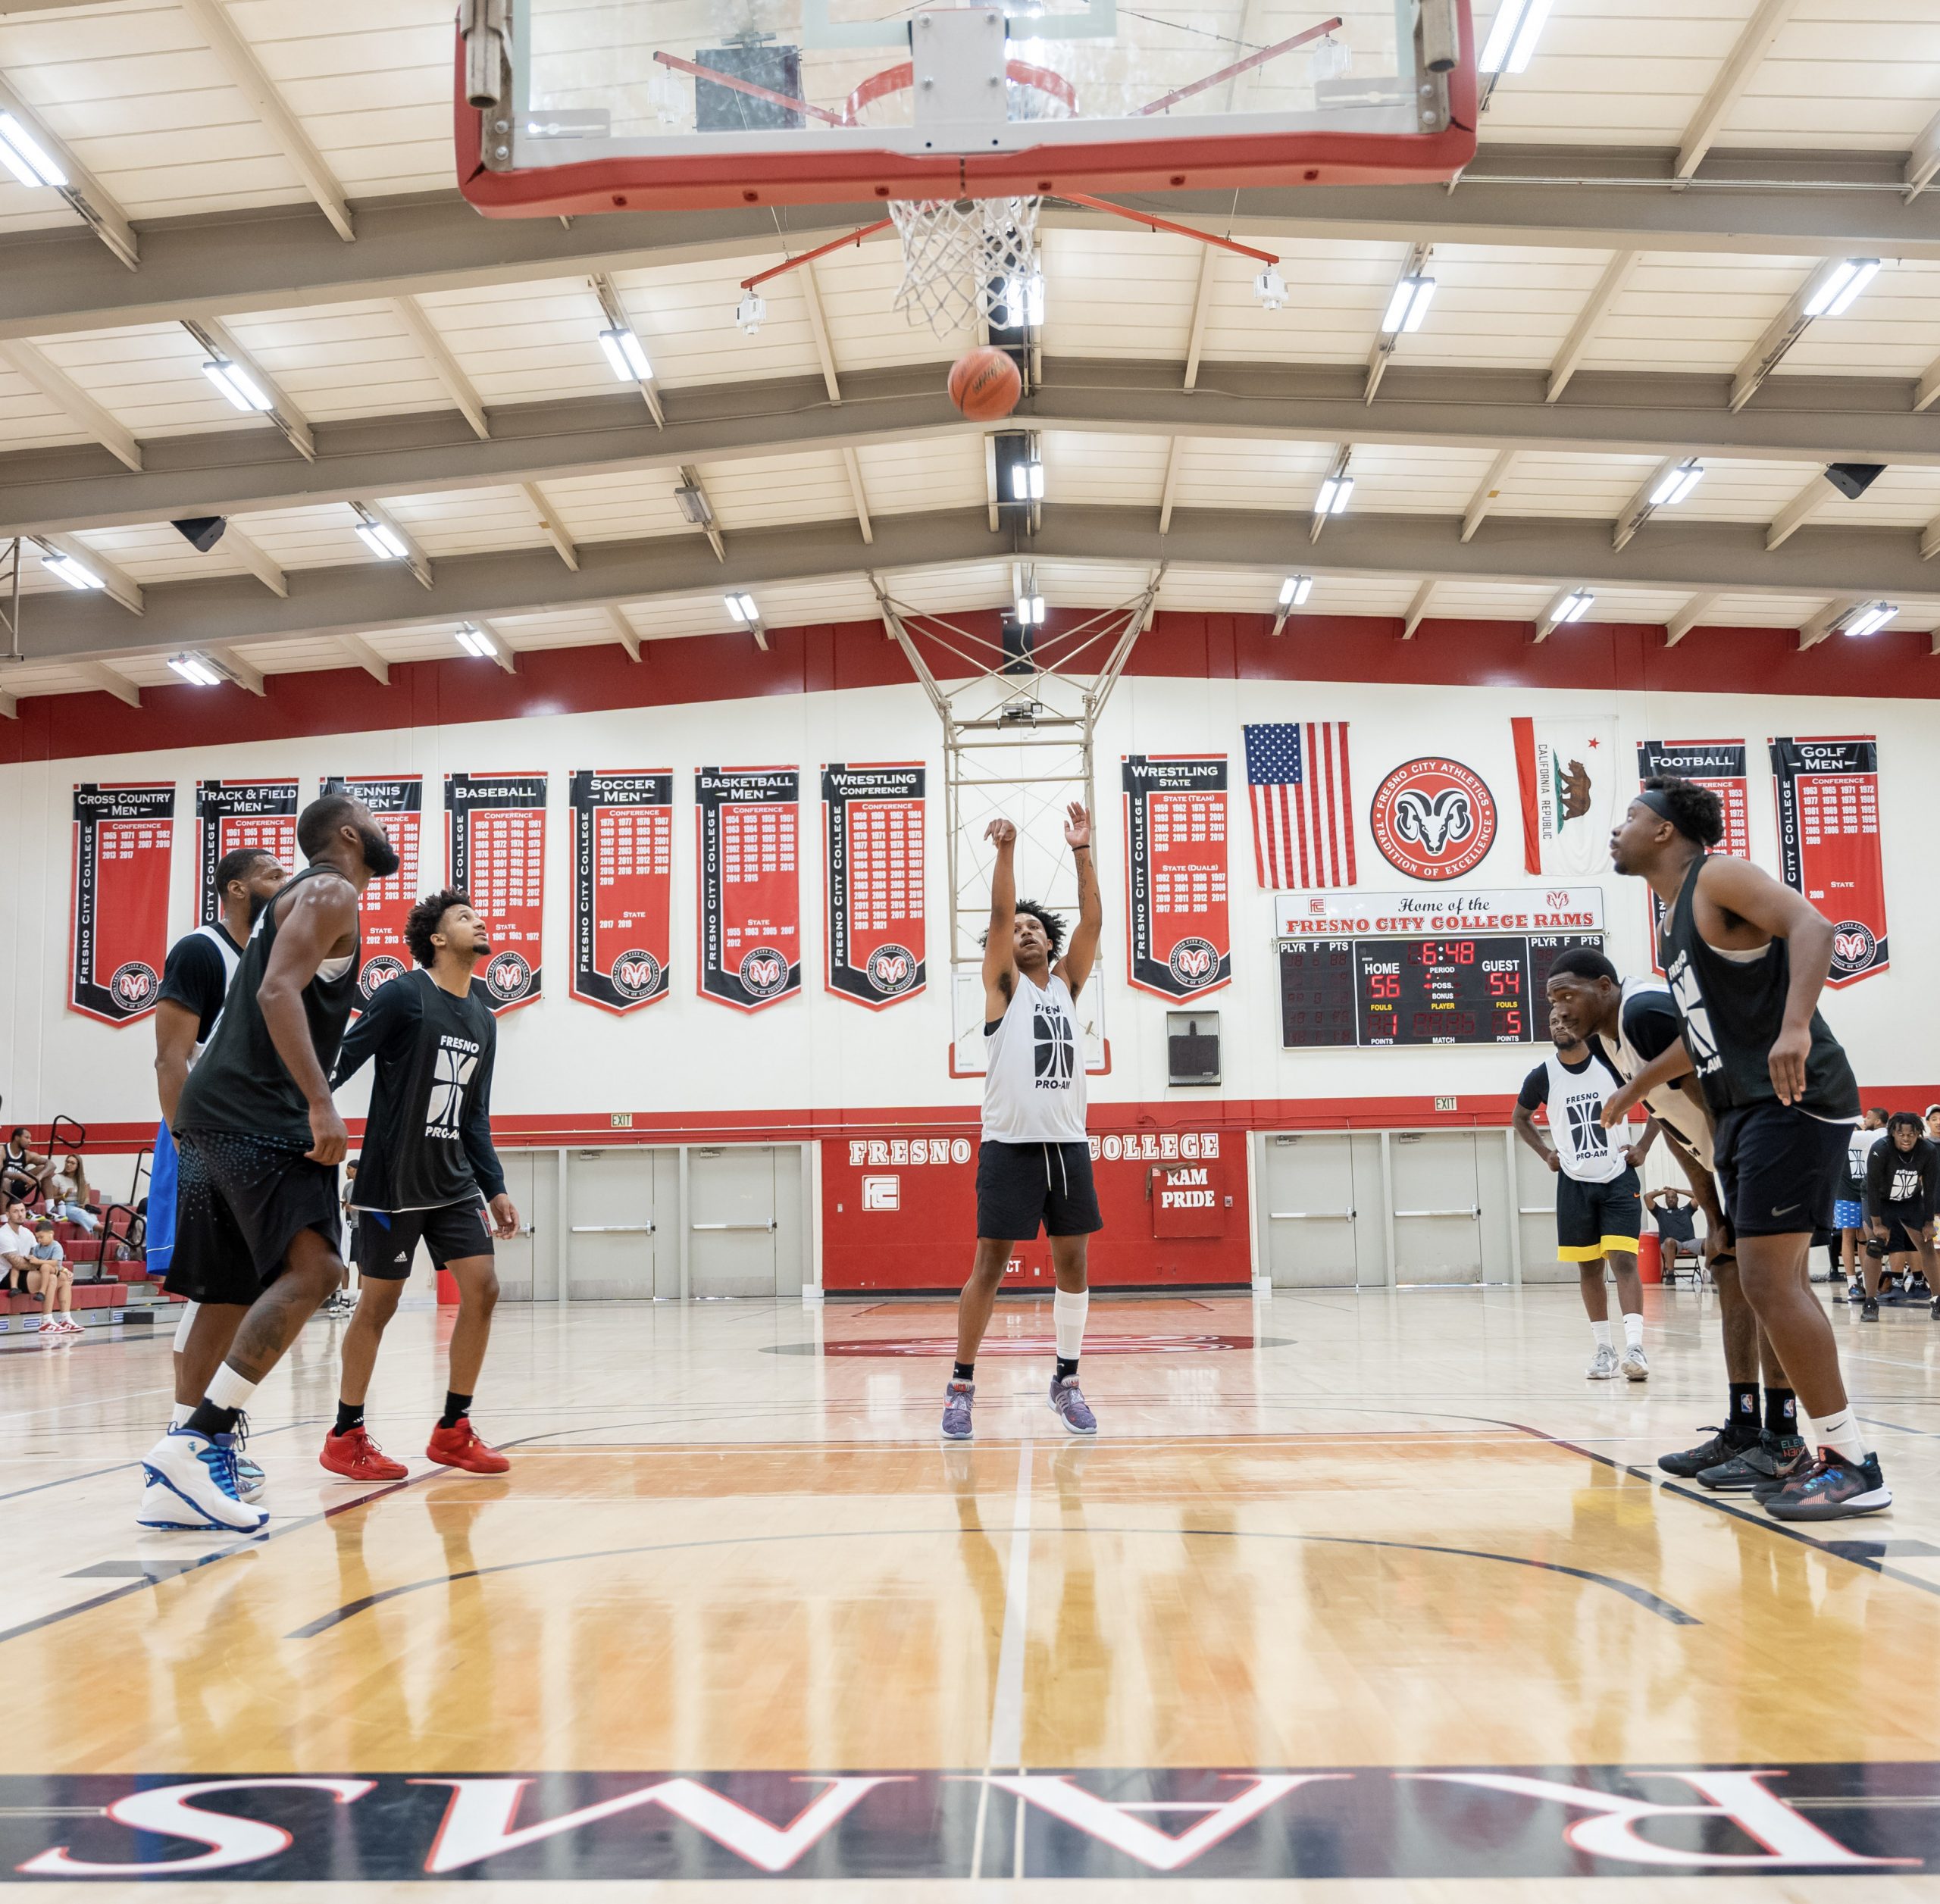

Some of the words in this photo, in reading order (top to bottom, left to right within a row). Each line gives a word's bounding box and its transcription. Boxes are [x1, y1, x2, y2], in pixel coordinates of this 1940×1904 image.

[1801, 747, 1846, 758] GOLF
[1538, 744, 1548, 794] CALIFORNIA
[1651, 756, 1734, 767] FOOTBALL
[1805, 759, 1843, 770] MEN
[831, 774, 917, 785] WRESTLING
[1131, 766, 1219, 777] WRESTLING
[343, 786, 400, 796] TENNIS
[591, 780, 655, 790] SOCCER
[702, 777, 793, 788] BASKETBALL
[840, 786, 908, 795] CONFERENCE
[1377, 770, 1408, 809] FRESNO
[1411, 761, 1437, 774] CITY
[1441, 762, 1489, 806] ATHLETICS
[78, 793, 115, 805] CROSS
[118, 793, 171, 803] COUNTRY
[199, 789, 242, 801] TRACK
[246, 789, 256, 799] &
[259, 789, 296, 799] FIELD
[455, 787, 537, 799] BASEBALL
[603, 792, 640, 802] MEN
[731, 789, 764, 800] MEN
[112, 805, 137, 815] MEN
[234, 802, 261, 812] MEN
[1784, 780, 1793, 844] COLLEGE
[1541, 800, 1552, 839] REPUBLIC
[206, 823, 215, 884] COLLEGE
[1375, 821, 1417, 873] TRADITION
[1423, 868, 1438, 877] OF
[1444, 819, 1491, 876] EXCELLENCE
[83, 826, 92, 888] COLLEGE
[1788, 849, 1796, 882] CITY
[834, 874, 843, 906] CITY
[83, 894, 91, 924] CITY
[205, 889, 215, 921] CITY
[1398, 897, 1443, 912] Home
[1447, 898, 1464, 914] of
[1469, 897, 1490, 911] the
[1286, 918, 1369, 933] FRESNO
[1375, 917, 1424, 932] CITY
[1431, 914, 1528, 930] COLLEGE
[1534, 911, 1594, 927] RAMS
[835, 911, 843, 967] FRESNO
[1137, 903, 1146, 959] FRESNO
[580, 917, 589, 972] FRESNO
[1281, 943, 1306, 953] PLYR
[1313, 943, 1319, 952] F
[1329, 943, 1348, 952] PTS
[1531, 937, 1557, 947] PLYR
[1564, 937, 1570, 946] F
[1581, 936, 1600, 946] PTS
[80, 930, 89, 984] FRESNO
[1422, 942, 1475, 965] 6:48
[1364, 963, 1400, 974] HOME
[1482, 960, 1519, 973] GUEST
[1372, 975, 1400, 999] 56
[1490, 973, 1520, 996] 54
[1507, 1011, 1522, 1033] 5
[440, 1035, 479, 1054] FRESNO
[1436, 1097, 1455, 1109] EXIT
[1566, 1092, 1599, 1105] FRESNO
[612, 1115, 630, 1126] EXIT
[849, 1138, 972, 1165] FRESNO
[1087, 1133, 1219, 1161] COLLEGE
[1576, 1150, 1607, 1161] PRO-AM
[1161, 1191, 1215, 1208] PRIDE
[15, 1769, 1923, 1877] RAMS
